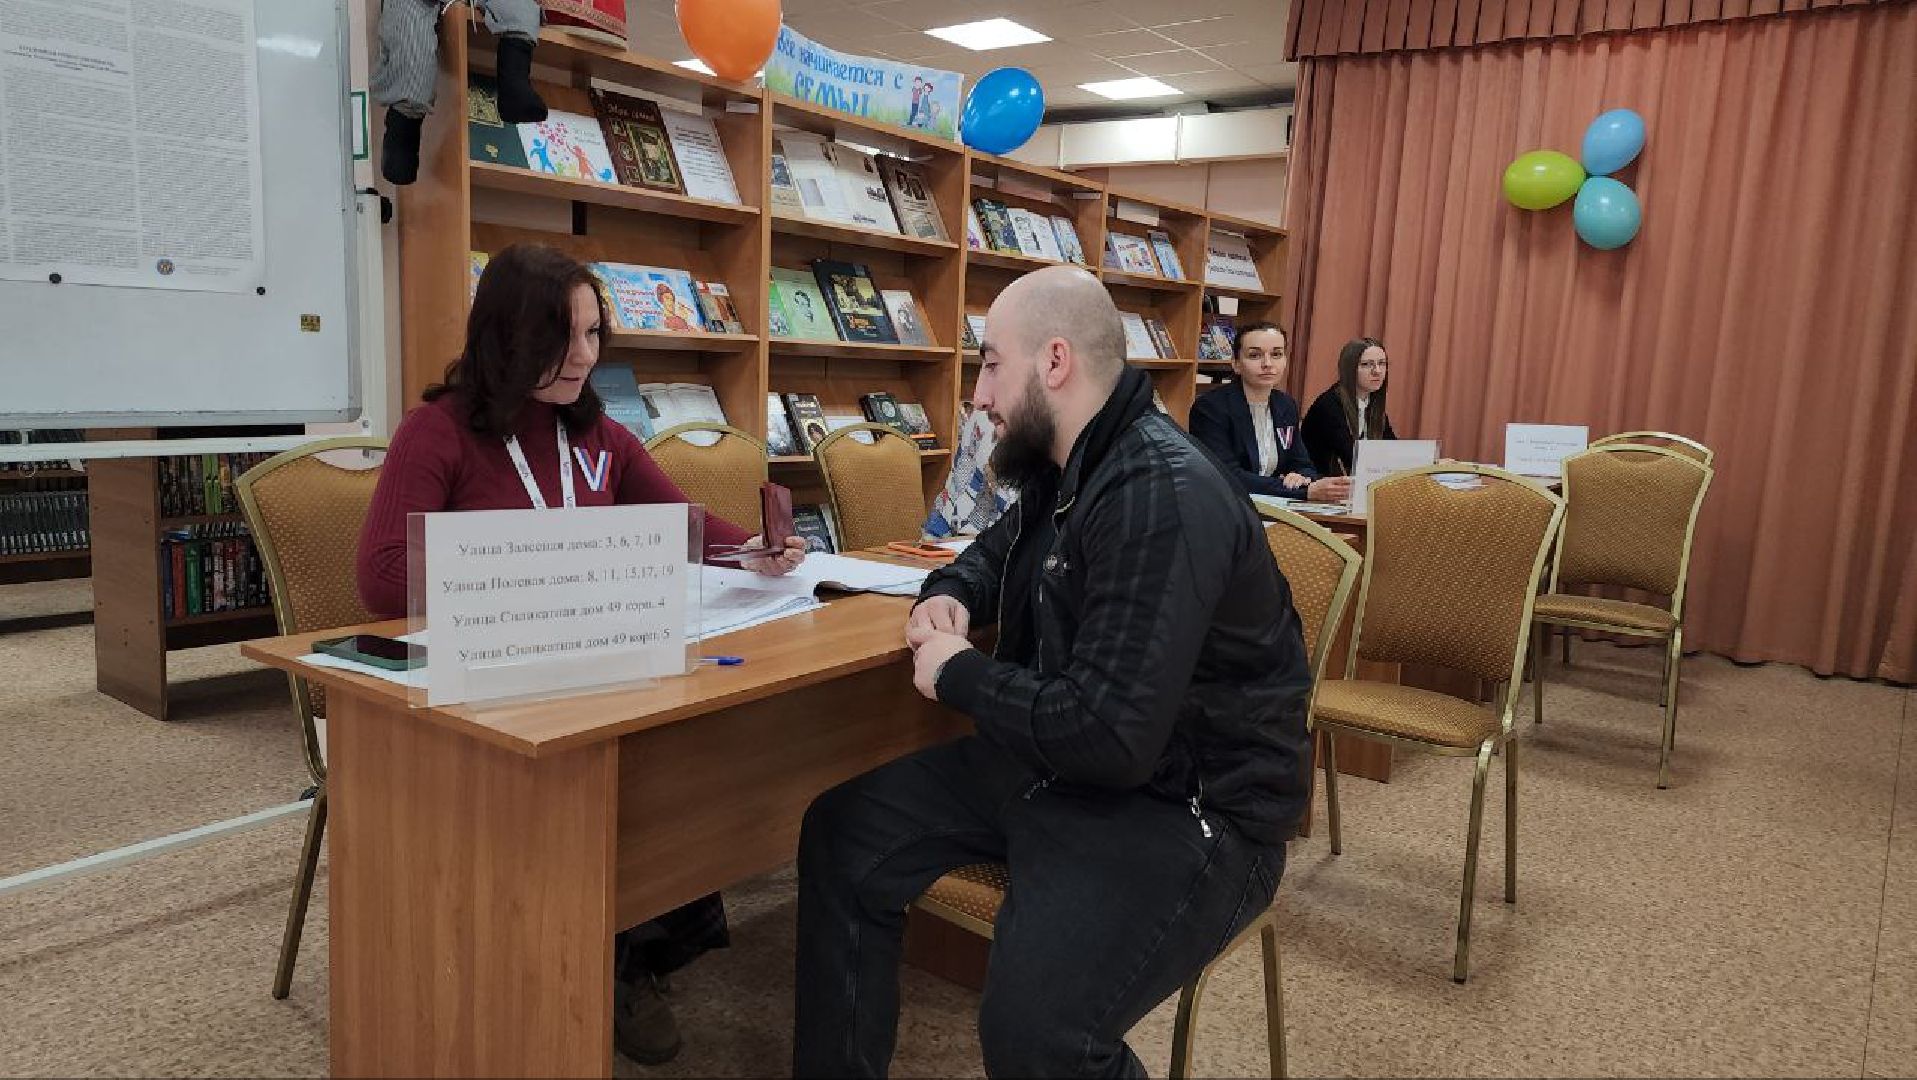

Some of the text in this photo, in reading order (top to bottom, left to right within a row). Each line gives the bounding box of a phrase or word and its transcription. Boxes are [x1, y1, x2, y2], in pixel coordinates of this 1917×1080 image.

[799, 46, 884, 87] начинается
[458, 544, 502, 556] Улица
[648, 533, 661, 546] 10
[443, 580, 486, 593] Улица
[452, 614, 496, 627] Улица
[580, 604, 604, 617] дом
[608, 601, 622, 612] 49
[459, 649, 502, 661] Улица
[585, 637, 609, 649] дом
[612, 632, 627, 644] 49
[663, 627, 671, 640] 5
